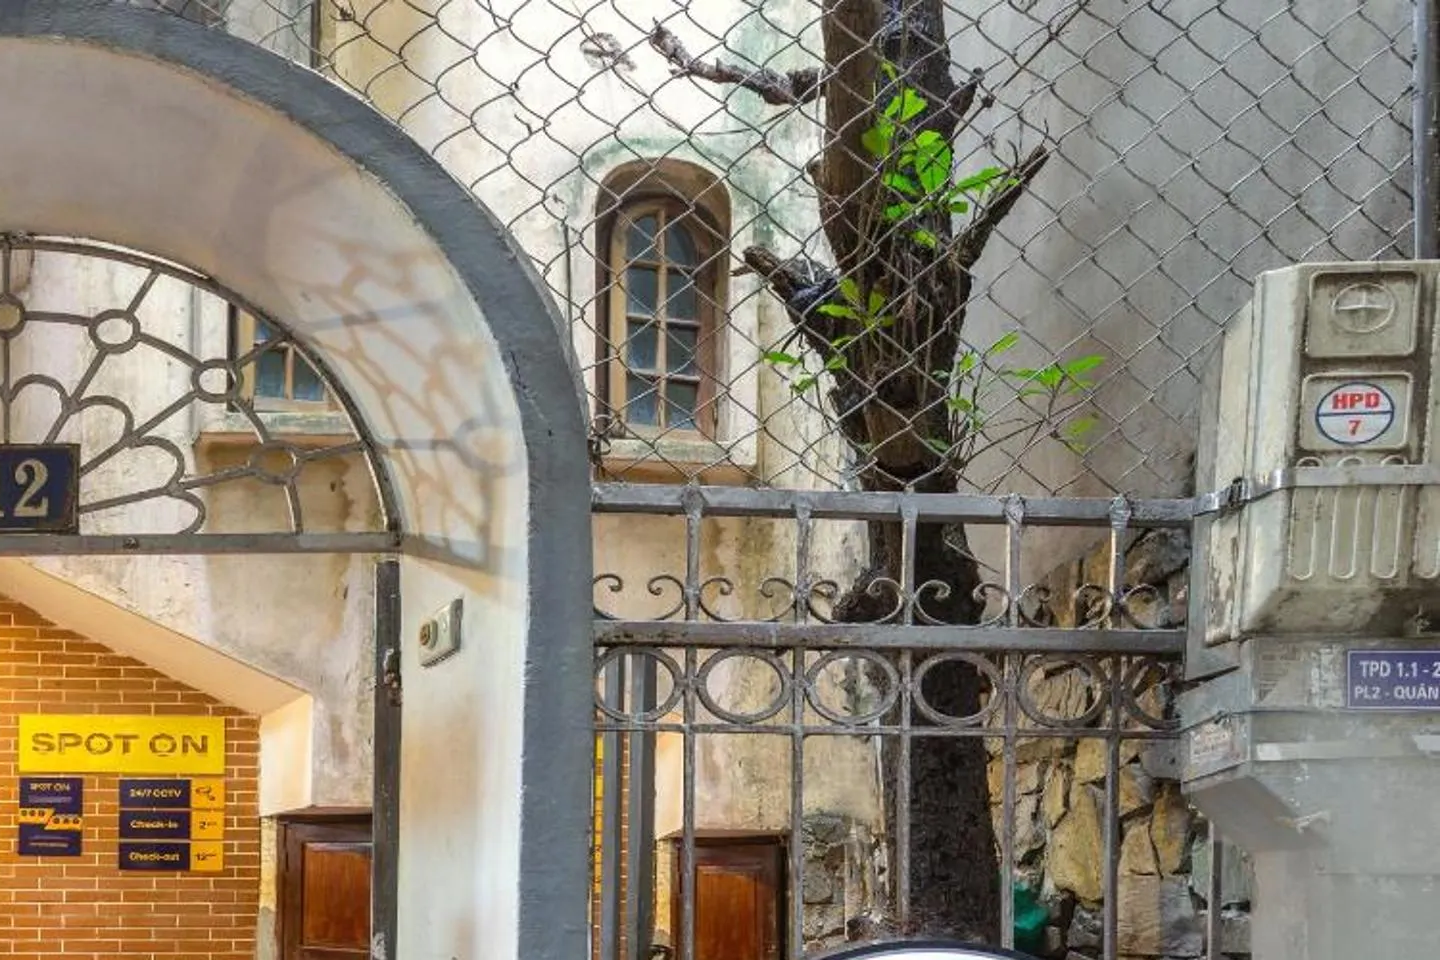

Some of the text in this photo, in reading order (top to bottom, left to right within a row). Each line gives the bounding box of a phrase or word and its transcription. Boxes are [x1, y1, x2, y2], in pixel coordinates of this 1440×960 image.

[1331, 392, 1381, 410] HPD
[1348, 420, 1361, 436] 7
[1359, 660, 1391, 678] TPD
[1397, 661, 1418, 678] 1.1
[1354, 686, 1381, 700] PL2
[31, 732, 209, 757] SPOT ON
[129, 788, 182, 798] 24/7 CCTV
